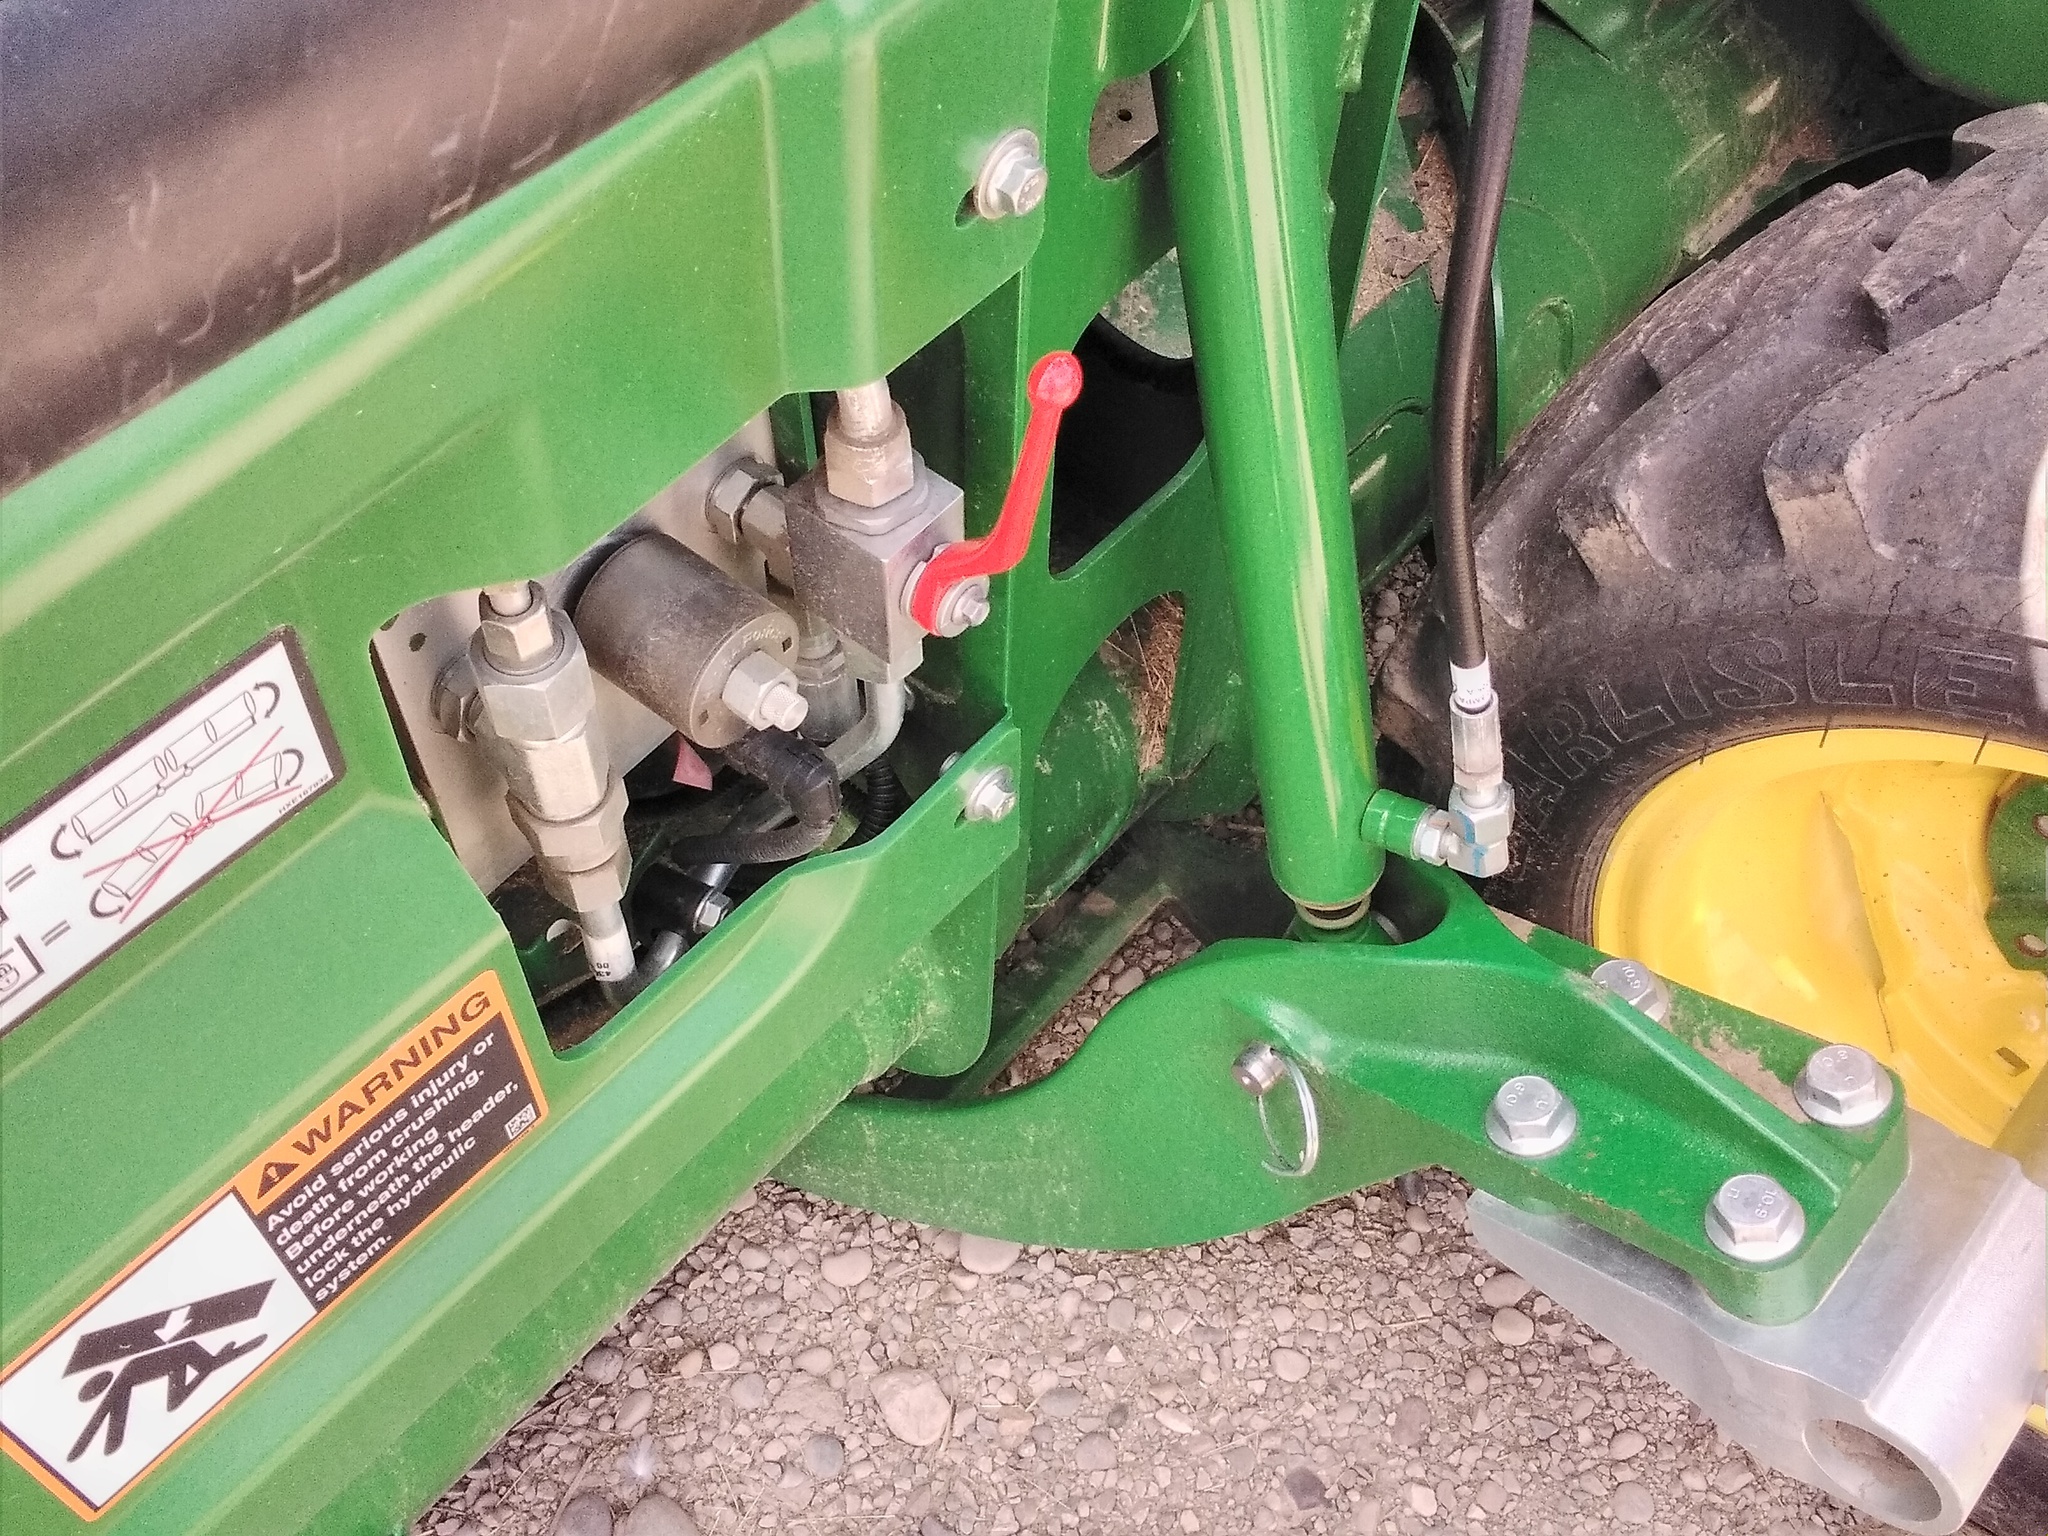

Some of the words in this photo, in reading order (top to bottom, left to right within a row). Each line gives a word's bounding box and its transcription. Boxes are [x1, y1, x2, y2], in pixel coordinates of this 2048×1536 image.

[267, 1176, 327, 1231] Avoid
[331, 1109, 408, 1177] serious
[411, 1056, 469, 1107] injury
[473, 1032, 495, 1056] or
[292, 989, 491, 1157] WARNING
[277, 1192, 335, 1246] death
[338, 1148, 388, 1192] from
[391, 1069, 484, 1148] crushing.
[285, 1199, 355, 1261] Before
[357, 1128, 439, 1198] working
[296, 1174, 409, 1275] underneath
[412, 1142, 445, 1173] the
[448, 1082, 519, 1144] header,
[304, 1249, 349, 1288] lock
[351, 1218, 384, 1249] the
[387, 1136, 477, 1218] hydraulic
[316, 1234, 392, 1302] system.
